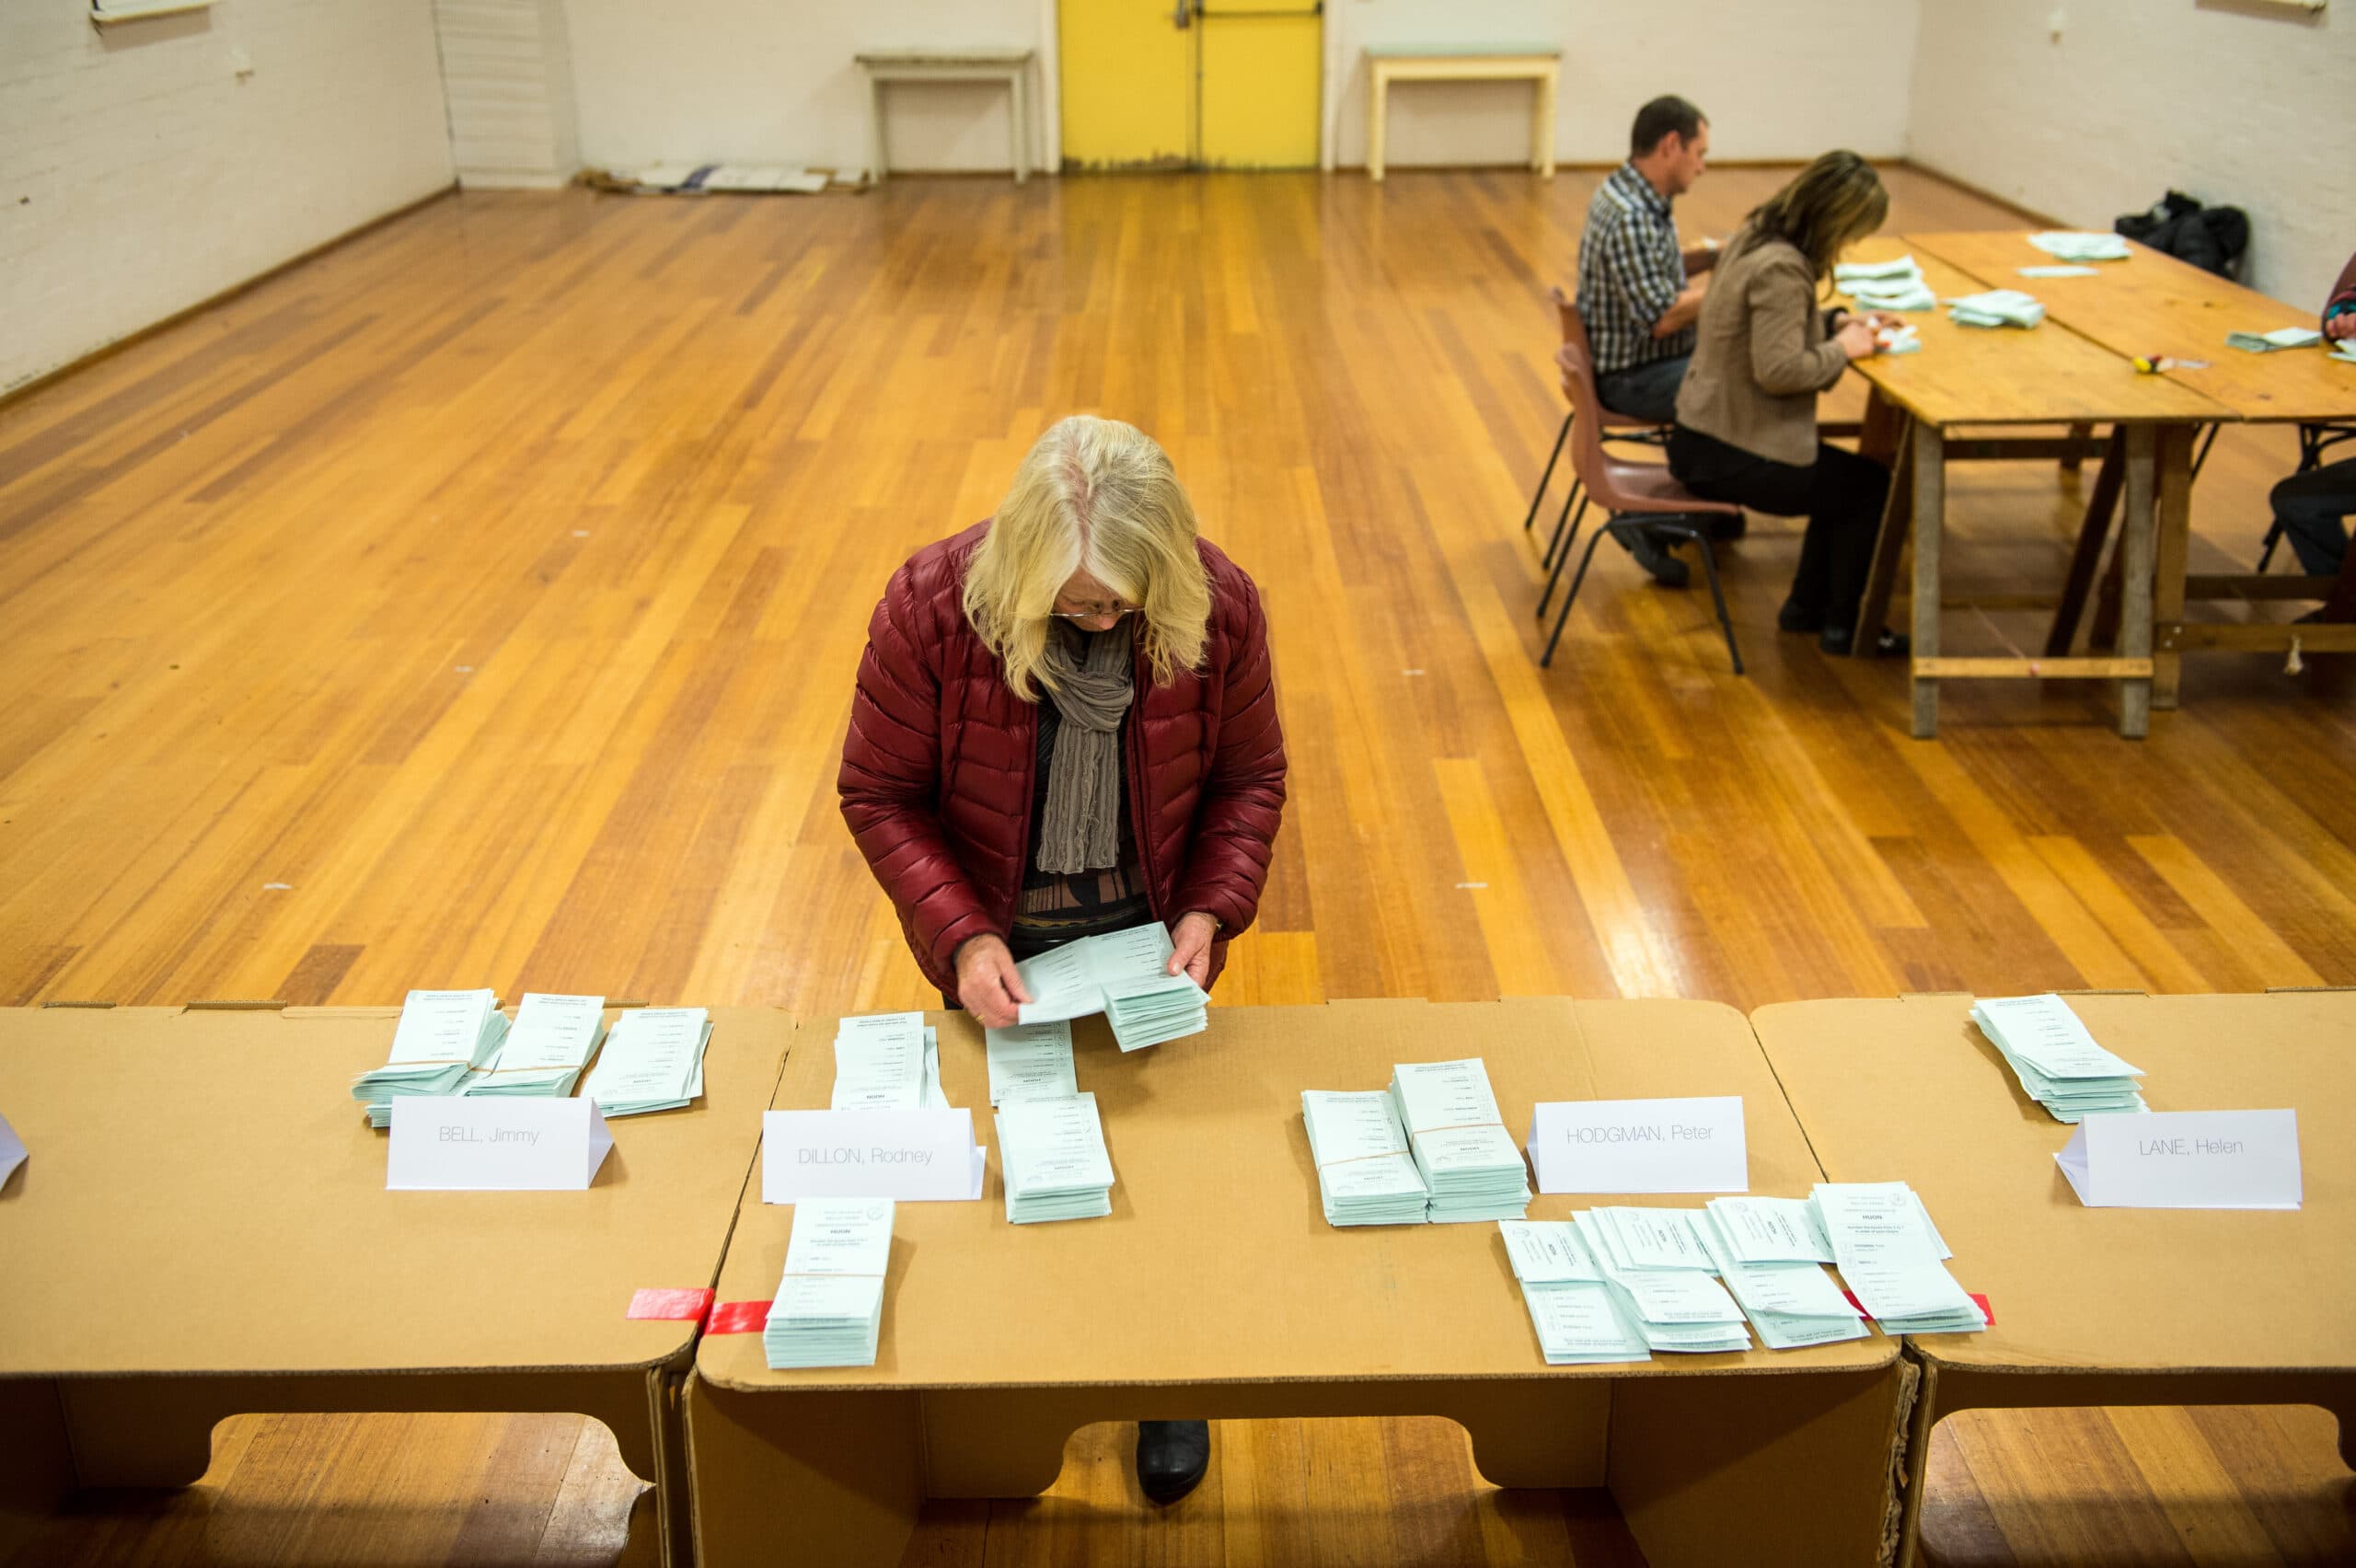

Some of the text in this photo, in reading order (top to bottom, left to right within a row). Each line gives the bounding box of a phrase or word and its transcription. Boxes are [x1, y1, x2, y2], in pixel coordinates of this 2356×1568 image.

[438, 1125, 540, 1147] BELL, Jimmy
[1566, 1124, 1715, 1145] HODGMAN, Peter
[2138, 1137, 2245, 1156] LANE, Helen
[797, 1147, 933, 1167] DILLON, Rodney
